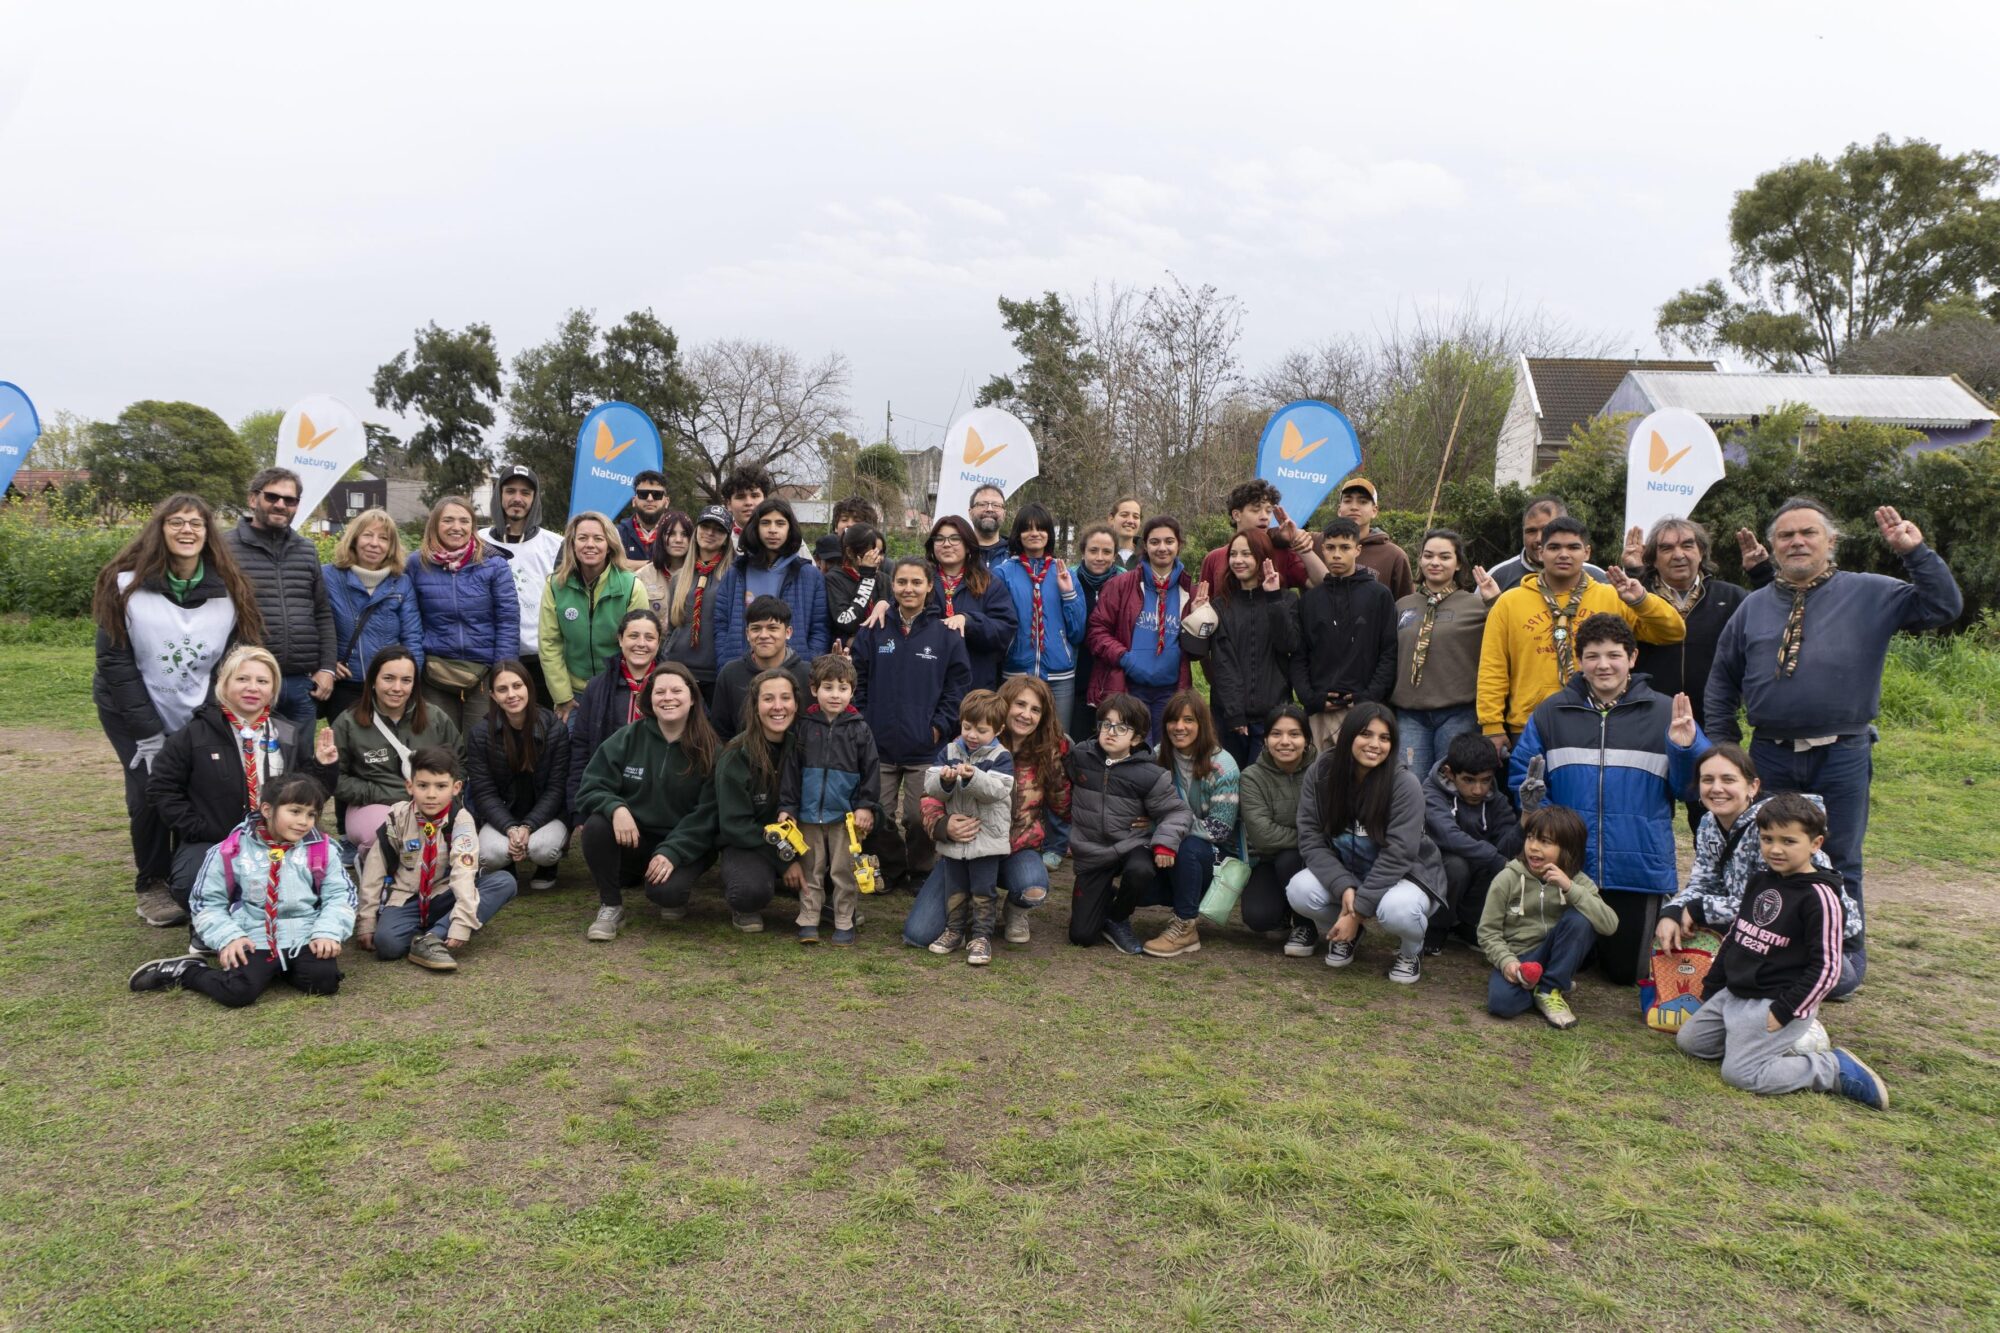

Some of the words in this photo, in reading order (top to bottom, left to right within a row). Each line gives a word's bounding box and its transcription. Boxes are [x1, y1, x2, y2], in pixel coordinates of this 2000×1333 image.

[293, 455, 338, 471] Naturgy
[591, 466, 636, 487] Naturgy
[960, 471, 1007, 489] Naturgy
[1277, 466, 1328, 485] Naturgy
[1647, 480, 1694, 496] Naturgy
